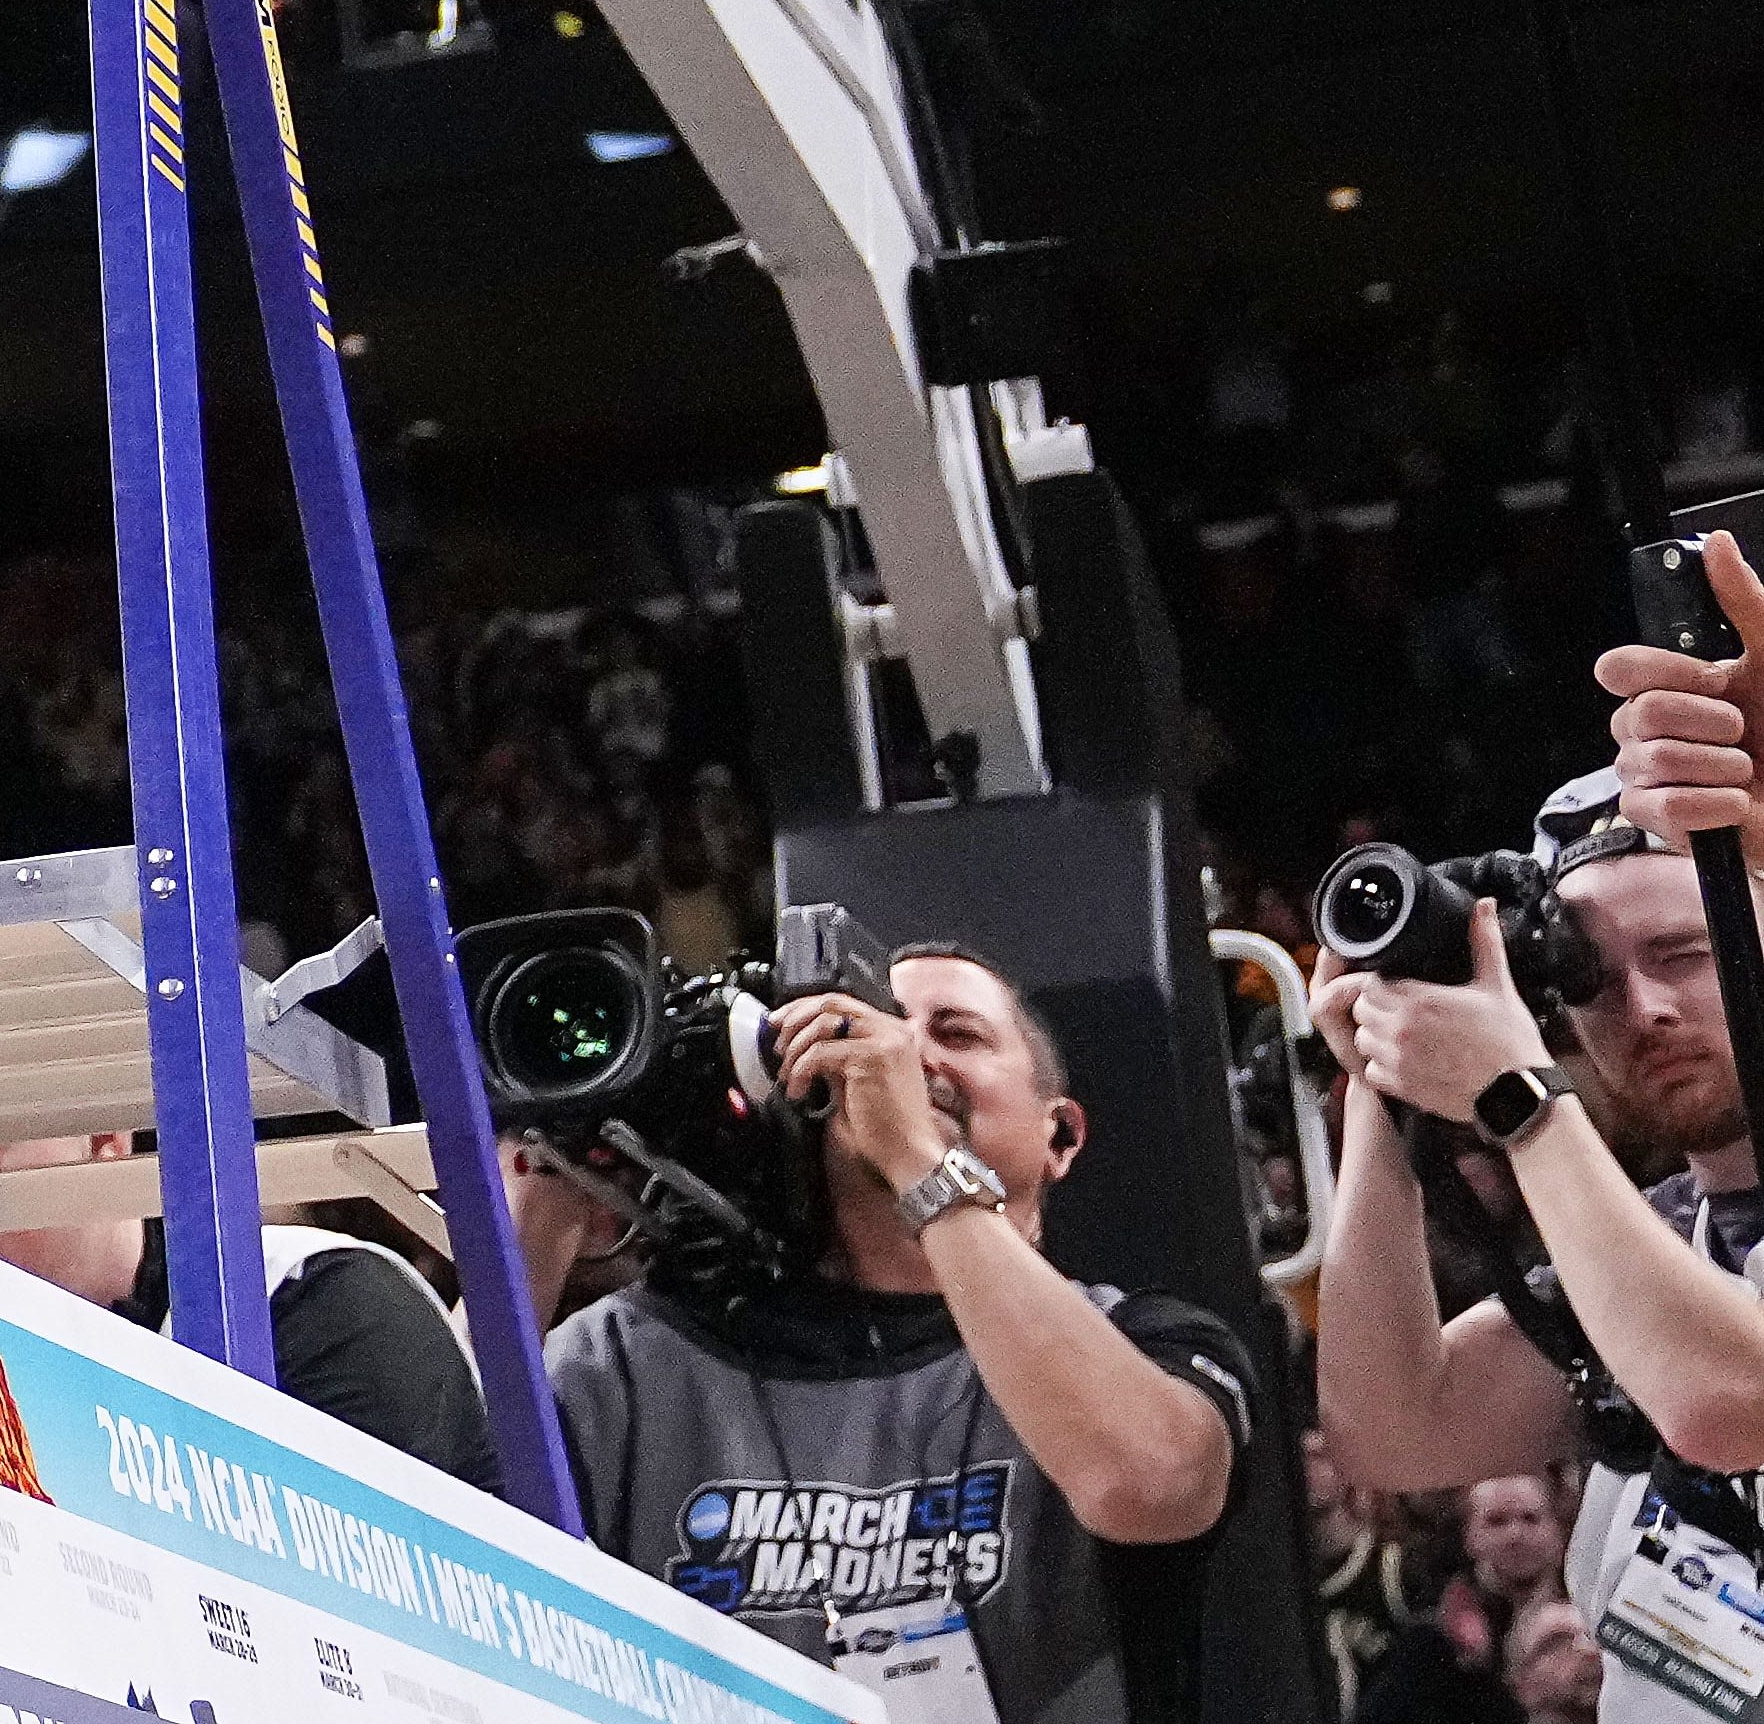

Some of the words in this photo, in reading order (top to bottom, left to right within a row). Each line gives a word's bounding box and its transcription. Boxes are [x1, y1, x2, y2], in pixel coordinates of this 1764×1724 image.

[95, 1404, 193, 1523] 2024
[280, 1484, 422, 1617] DIVISION
[430, 1552, 523, 1660] MEN'S
[728, 1490, 916, 1547] MARCH
[198, 1593, 234, 1632] SWEET
[234, 1607, 251, 1637] 16
